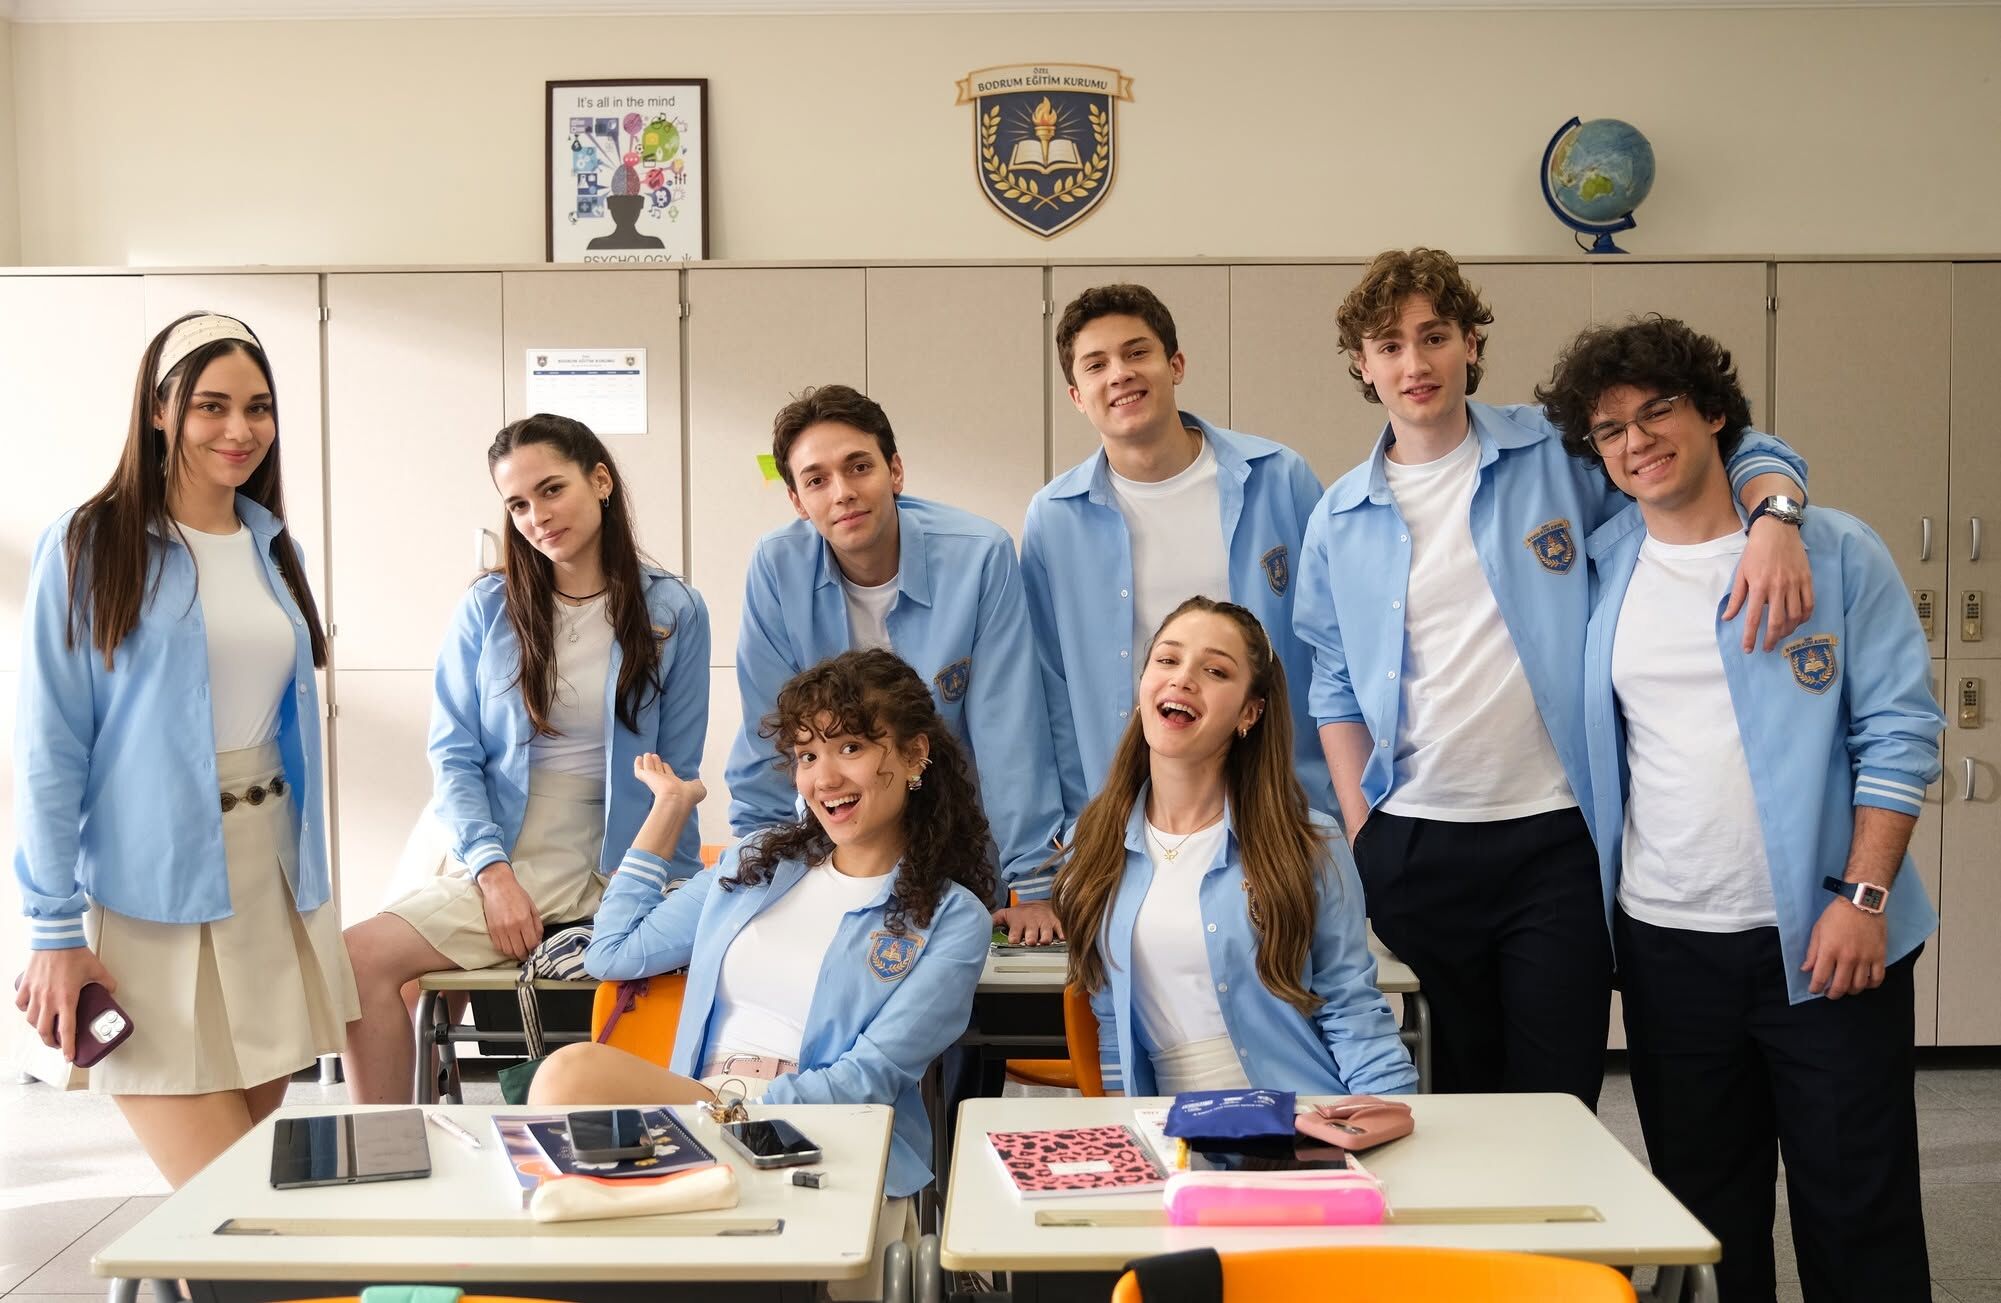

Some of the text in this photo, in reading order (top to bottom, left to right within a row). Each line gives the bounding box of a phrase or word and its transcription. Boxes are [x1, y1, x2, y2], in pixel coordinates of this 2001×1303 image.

[977, 74, 1108, 92] BODRUM EĞİTİM KURUMU
[577, 95, 675, 108] It's all in the mind
